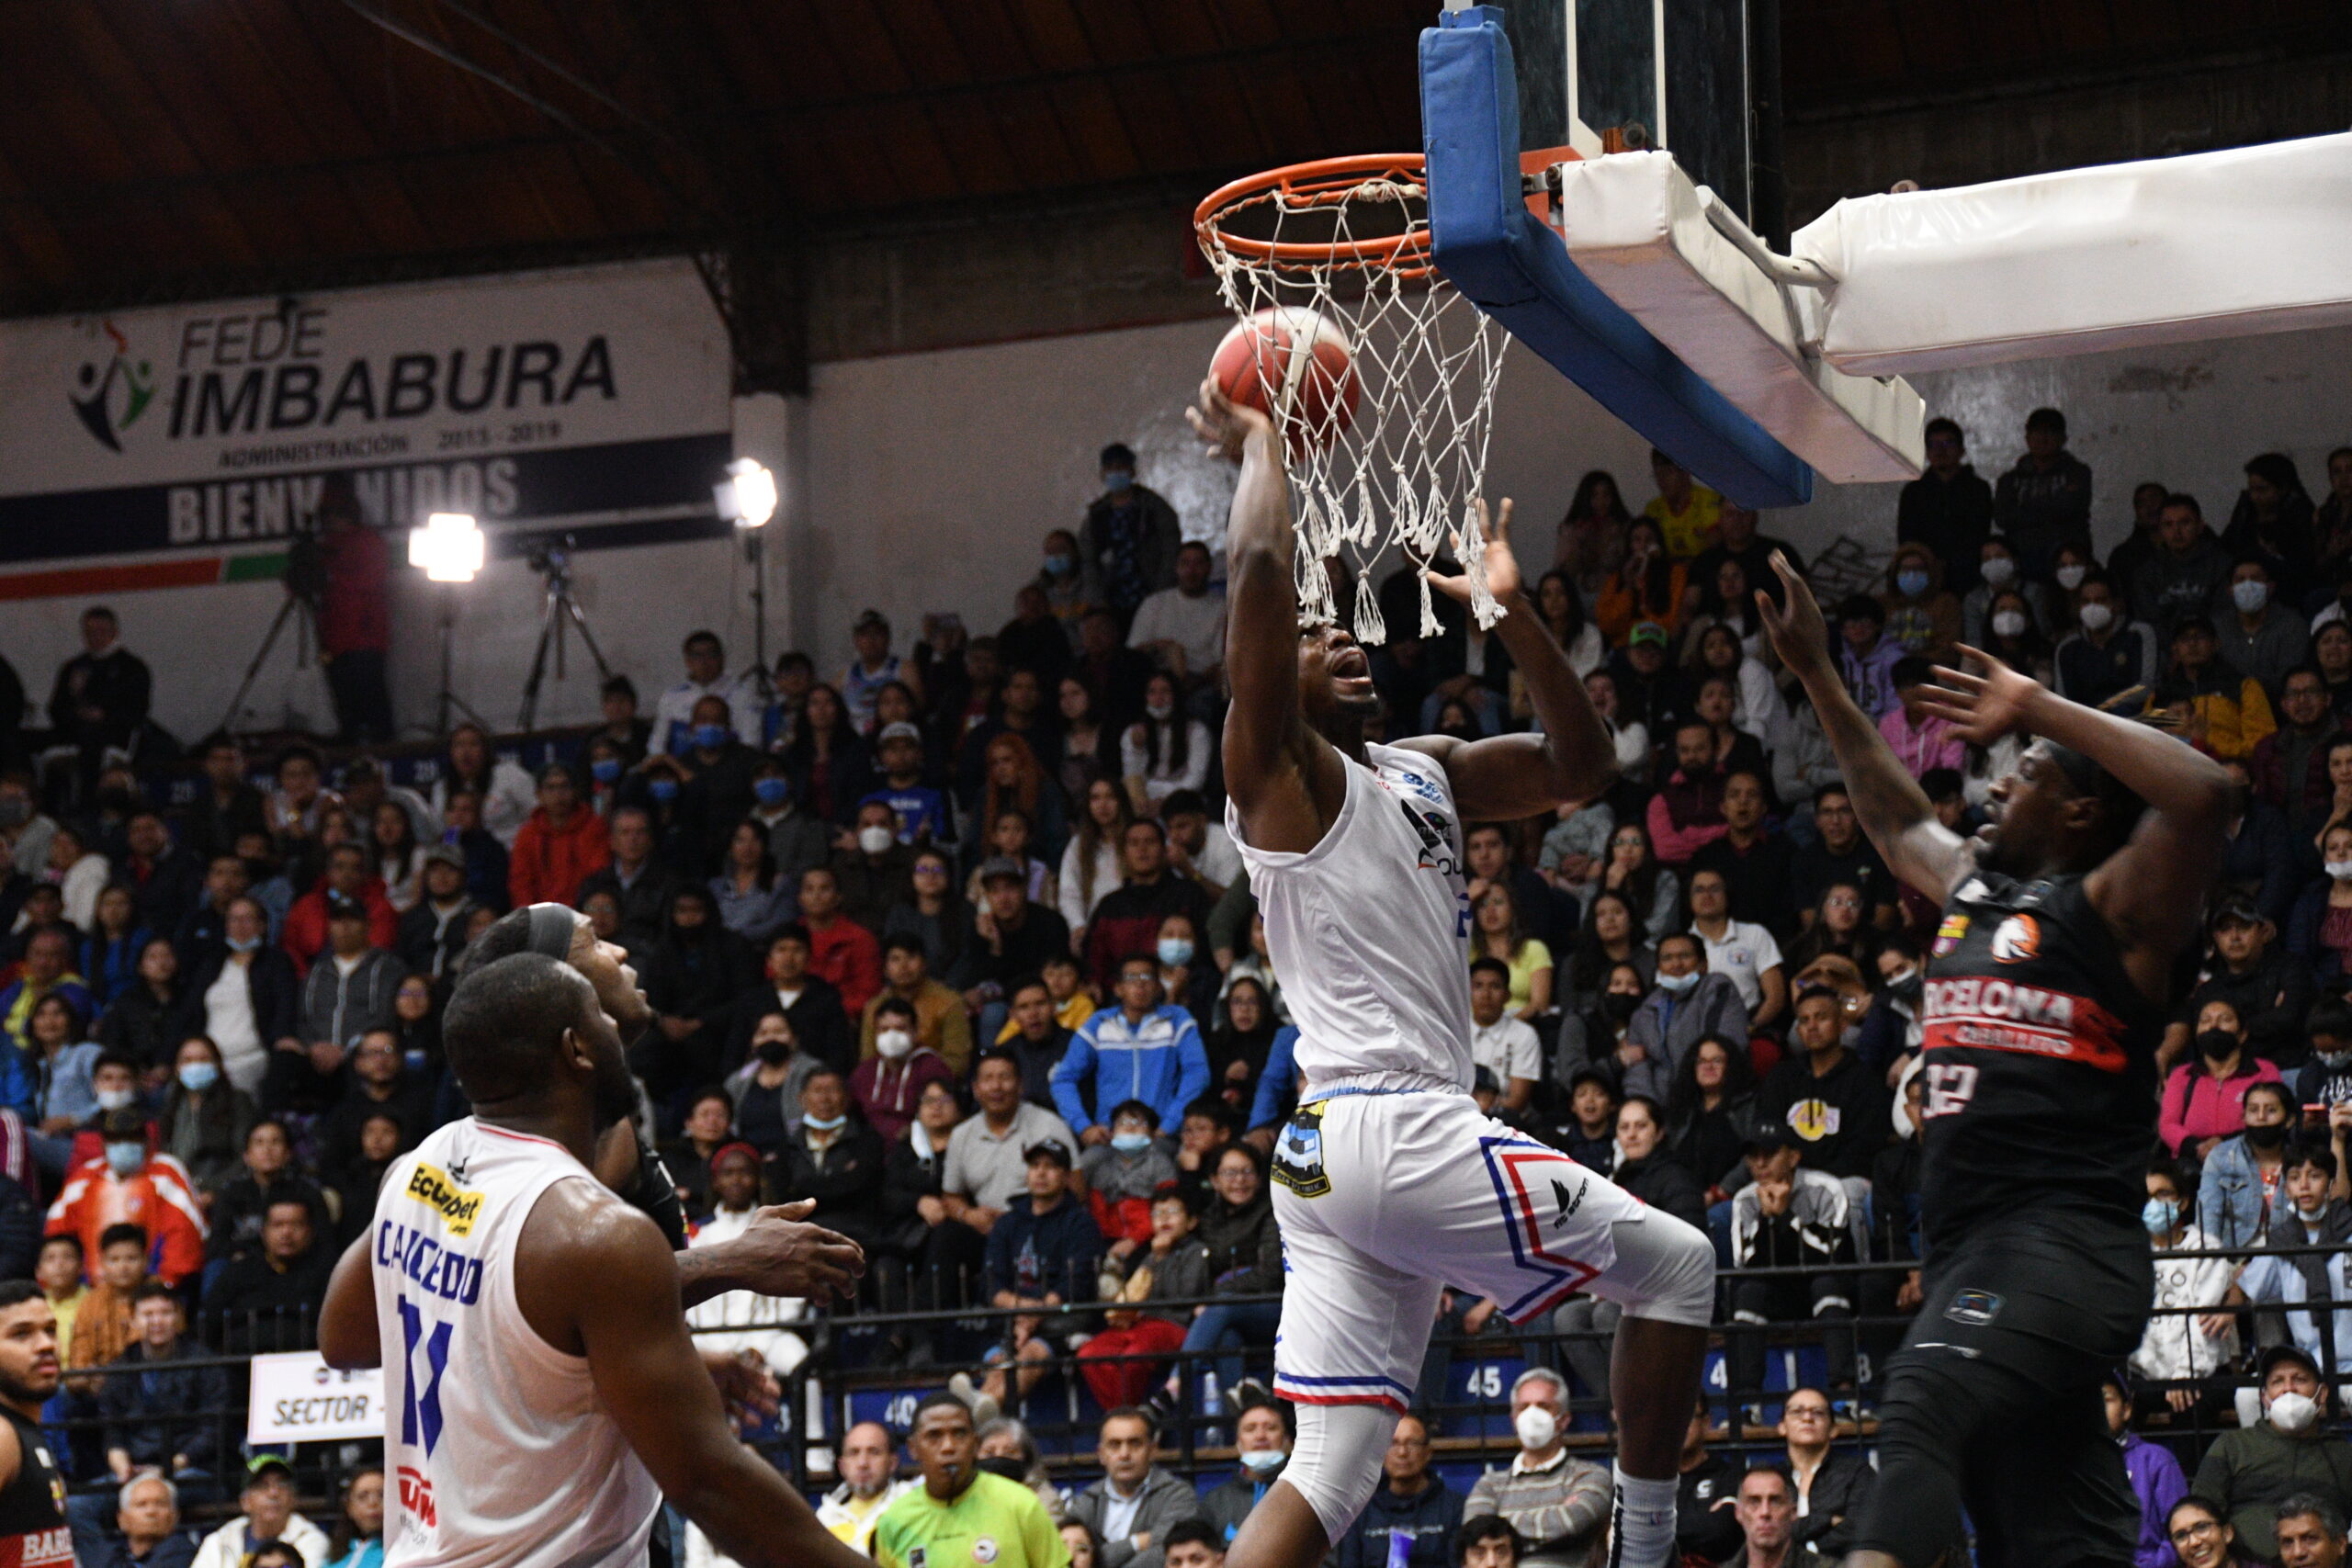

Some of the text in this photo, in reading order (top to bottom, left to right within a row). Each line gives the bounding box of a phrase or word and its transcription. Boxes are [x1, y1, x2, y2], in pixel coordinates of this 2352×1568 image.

[179, 309, 327, 367] FEDE
[168, 335, 616, 439] IMBABURA
[168, 457, 518, 544] BIENVNIDOS
[1466, 1364, 1502, 1399] 45
[273, 1395, 369, 1427] SECTOR
